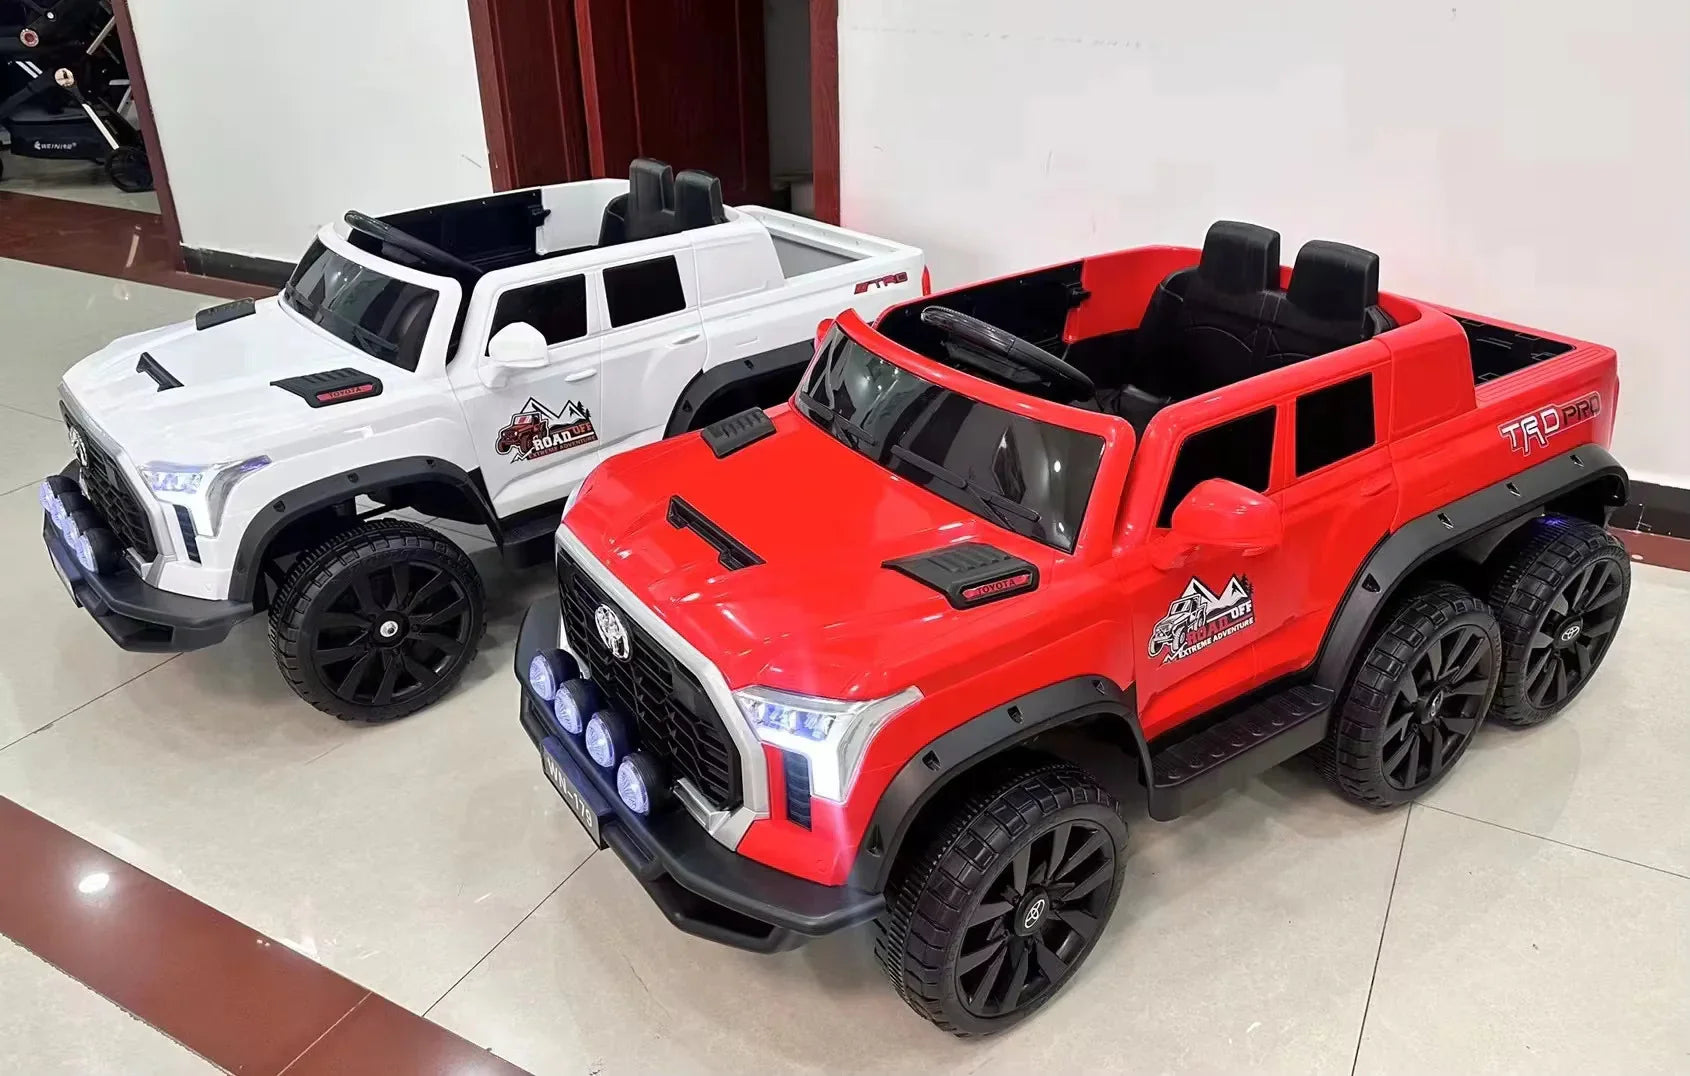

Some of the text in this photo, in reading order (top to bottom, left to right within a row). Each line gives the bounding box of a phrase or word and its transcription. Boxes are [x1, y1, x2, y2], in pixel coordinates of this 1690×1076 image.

[329, 387, 361, 398] TOYOTA
[533, 422, 593, 451] ROAD OFF
[1501, 394, 1601, 453] TRD PRO
[528, 435, 597, 459] EXTREME ADVENTURE
[977, 579, 1016, 595] TOYOTA
[1186, 600, 1252, 645] ROAD OFF
[1179, 617, 1254, 658] EXTREME ADVENTURE
